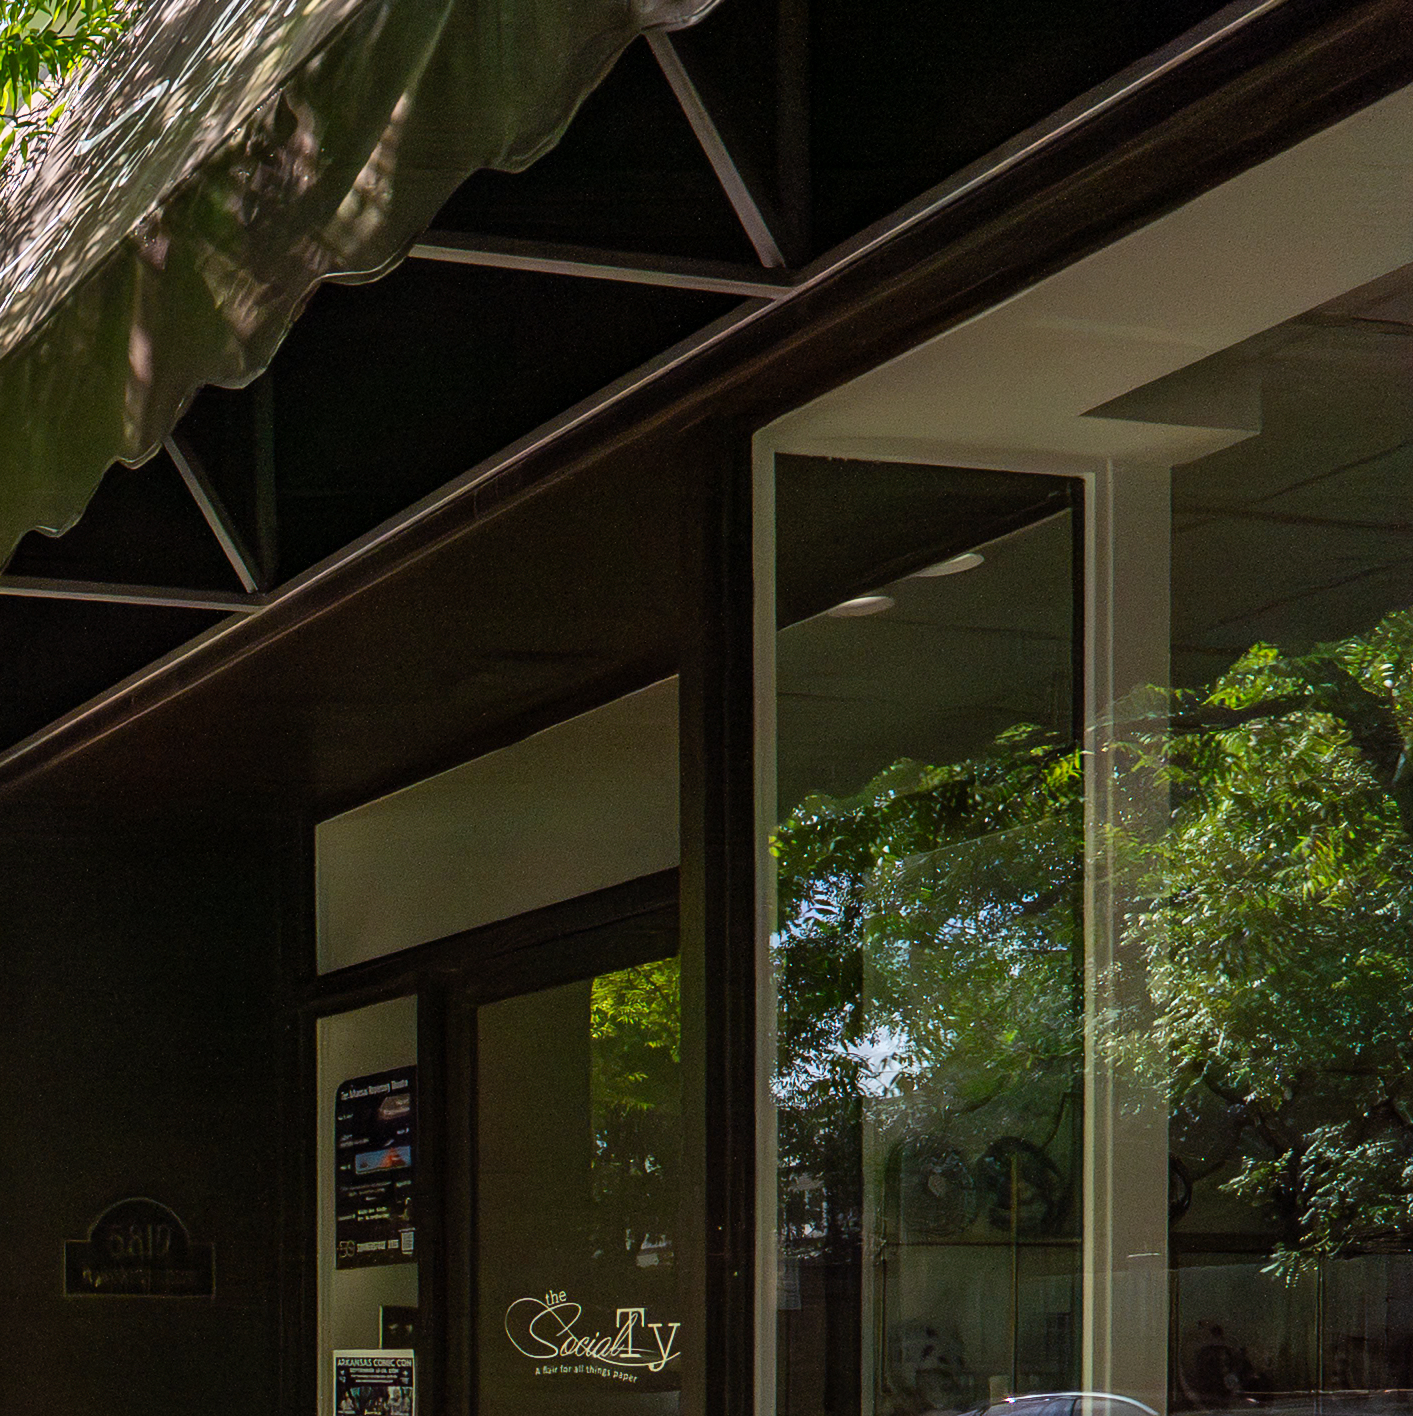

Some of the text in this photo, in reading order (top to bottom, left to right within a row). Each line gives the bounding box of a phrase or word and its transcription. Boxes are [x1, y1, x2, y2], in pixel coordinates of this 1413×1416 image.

[545, 1289, 567, 1306] the
[560, 1364, 572, 1374] for
[573, 1364, 584, 1373] all
[586, 1365, 611, 1377] things
[613, 1370, 638, 1384] paper
